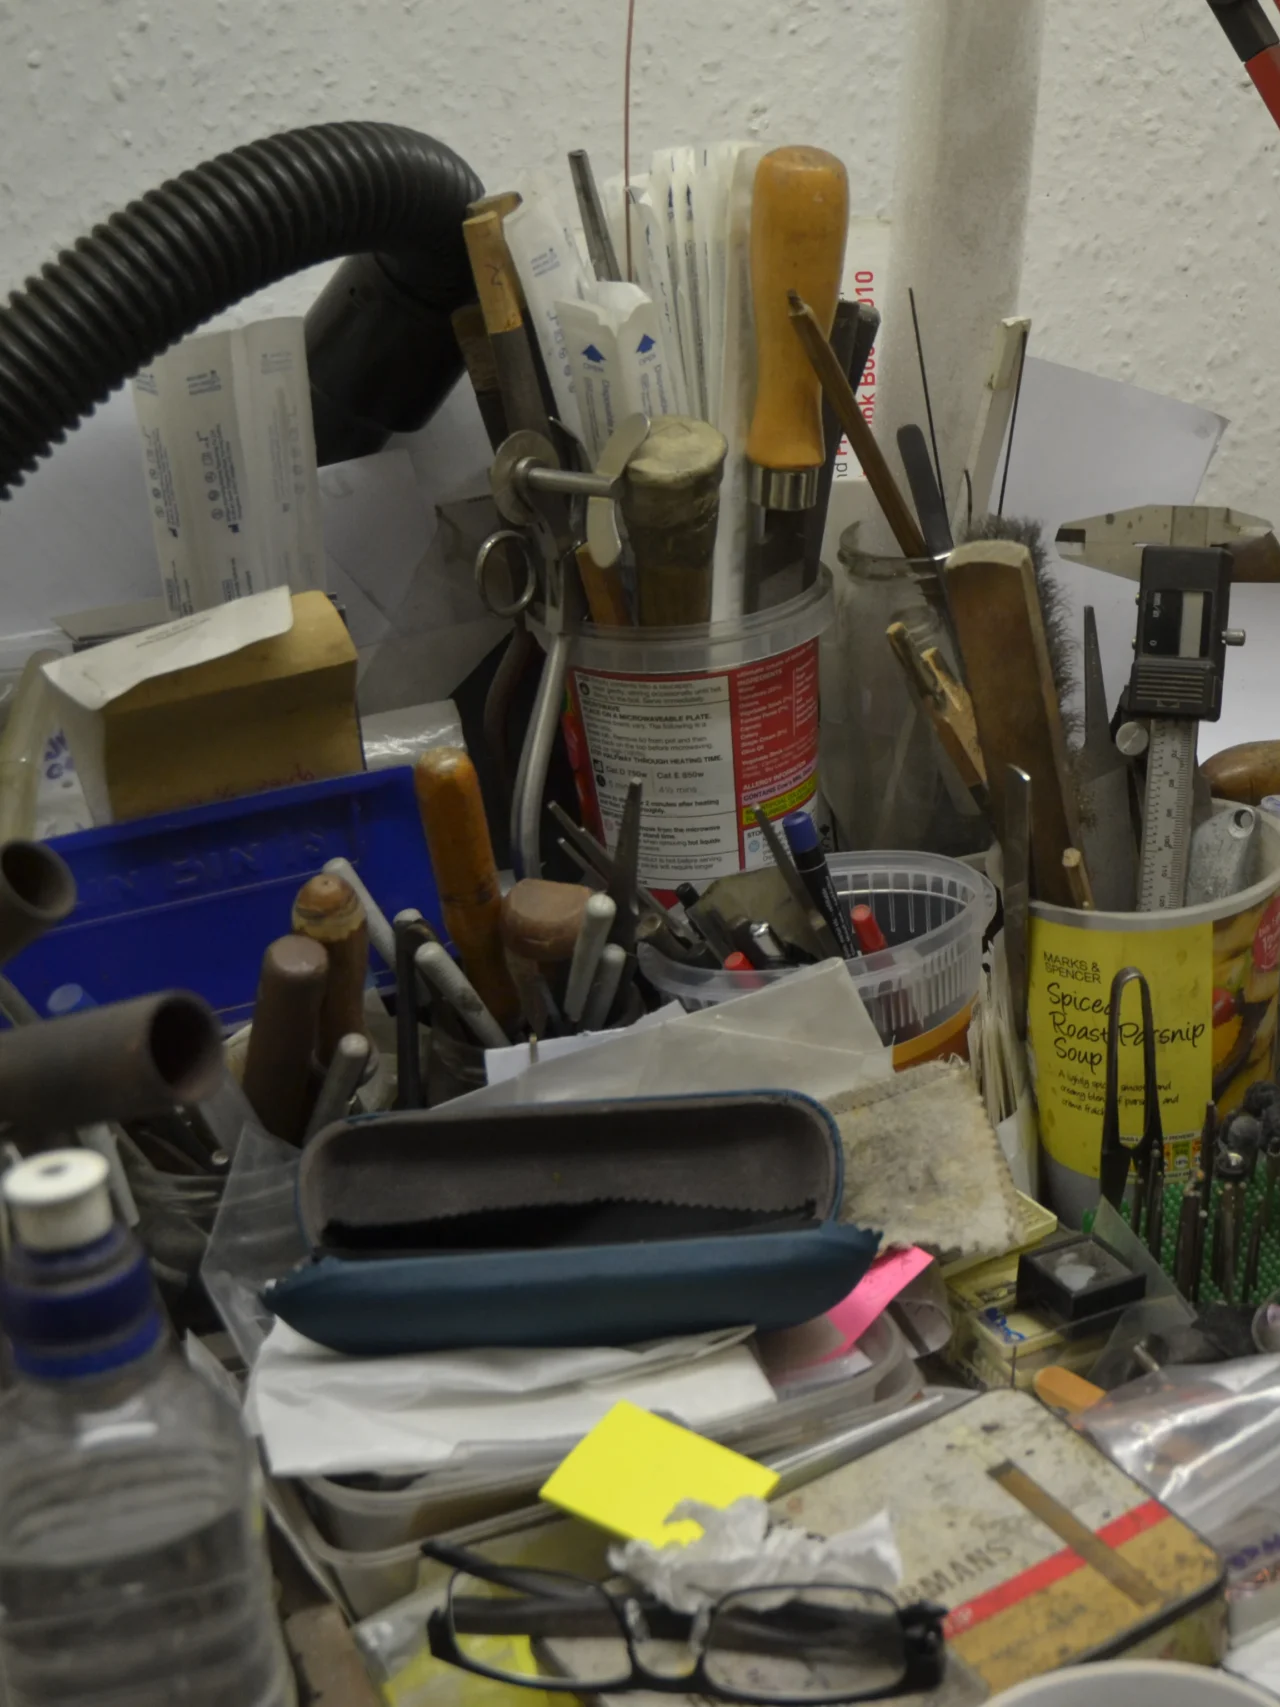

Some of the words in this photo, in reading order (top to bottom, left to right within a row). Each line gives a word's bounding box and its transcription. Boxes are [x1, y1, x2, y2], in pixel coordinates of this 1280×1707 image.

[1044, 950, 1089, 971] MARKS
[1090, 961, 1102, 974] &
[1045, 961, 1103, 984] SPENCER
[1049, 1010, 1109, 1045] Roast
[1053, 1036, 1103, 1076] Soup
